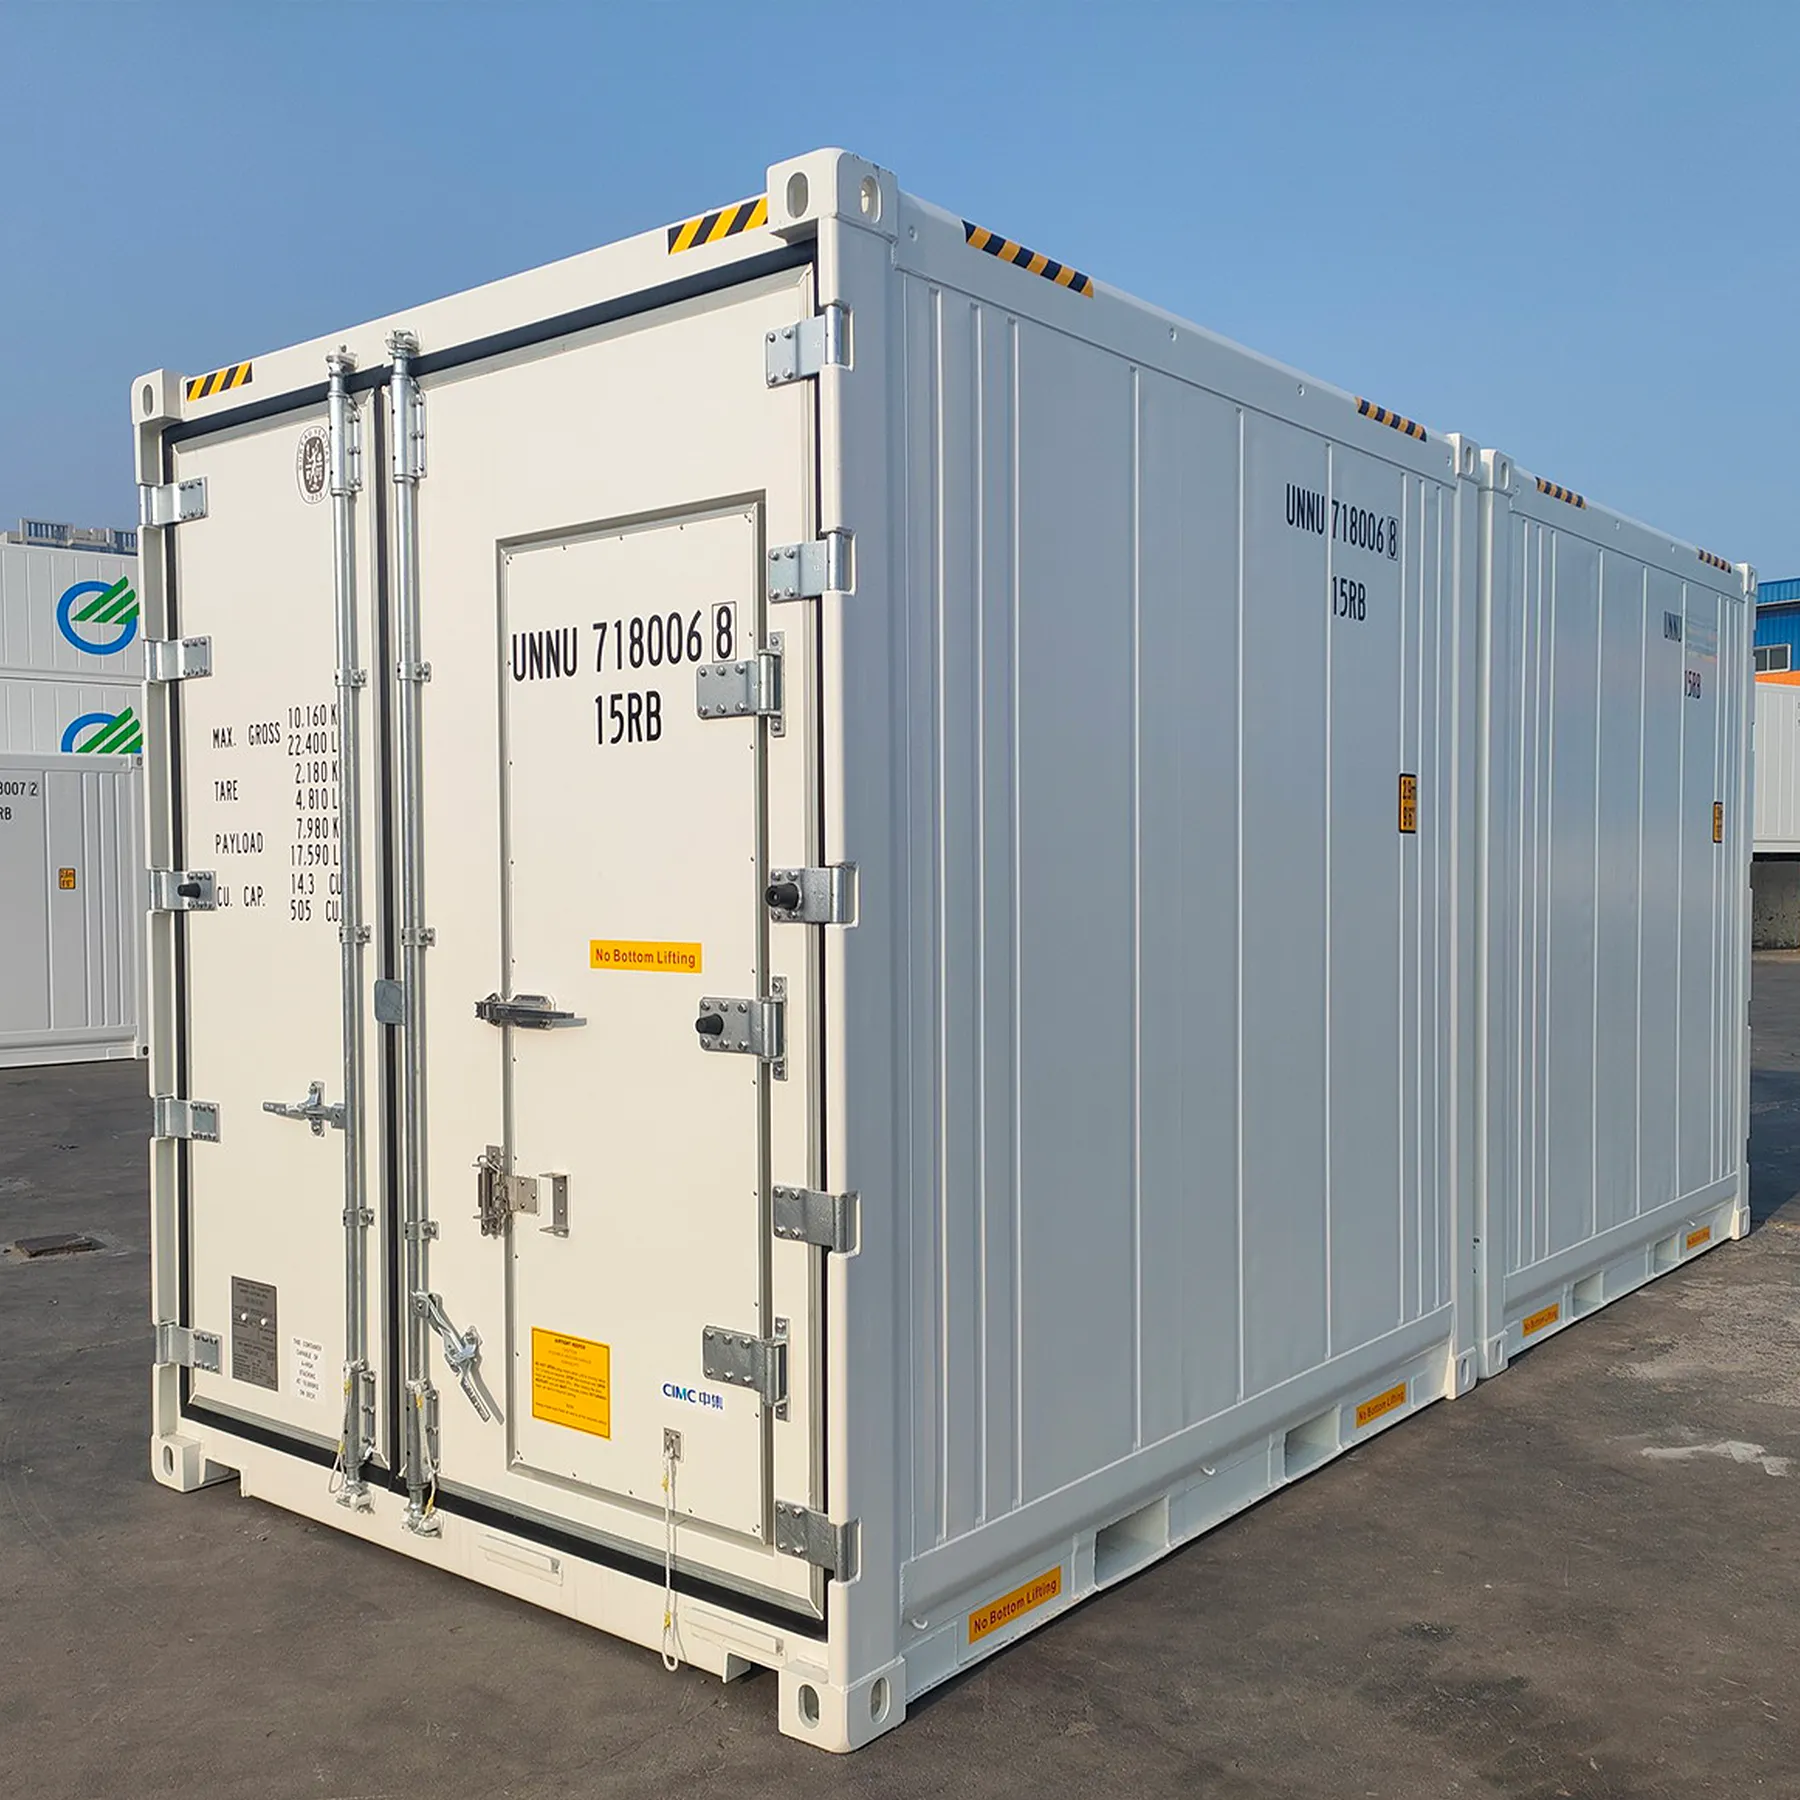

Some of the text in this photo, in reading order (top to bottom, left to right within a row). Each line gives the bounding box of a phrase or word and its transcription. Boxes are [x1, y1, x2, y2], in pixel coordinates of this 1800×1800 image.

[1286, 483, 1325, 535] UNNU
[1332, 499, 1384, 553] 718006
[1332, 576, 1366, 621] 15RB
[513, 627, 577, 682] UNNU
[593, 610, 702, 673] 718006
[288, 704, 327, 729] 10.160
[595, 691, 662, 744] 15RB
[212, 722, 281, 748] MAX. GROSS
[288, 732, 327, 756] 22.400
[295, 761, 328, 784] 2.180
[214, 780, 239, 801] TARE
[296, 788, 328, 810] 4.810
[296, 817, 329, 839] 7.980
[215, 832, 264, 854] PAYLOAD
[291, 844, 329, 866] 17.590
[291, 873, 315, 895] 14.3
[216, 886, 266, 908] CU. CAP.
[291, 899, 312, 922] 505
[595, 948, 695, 968] No Bottom Lifting
[662, 1383, 696, 1403] CIMC
[974, 1580, 1057, 1633] No Bottom Lifting
